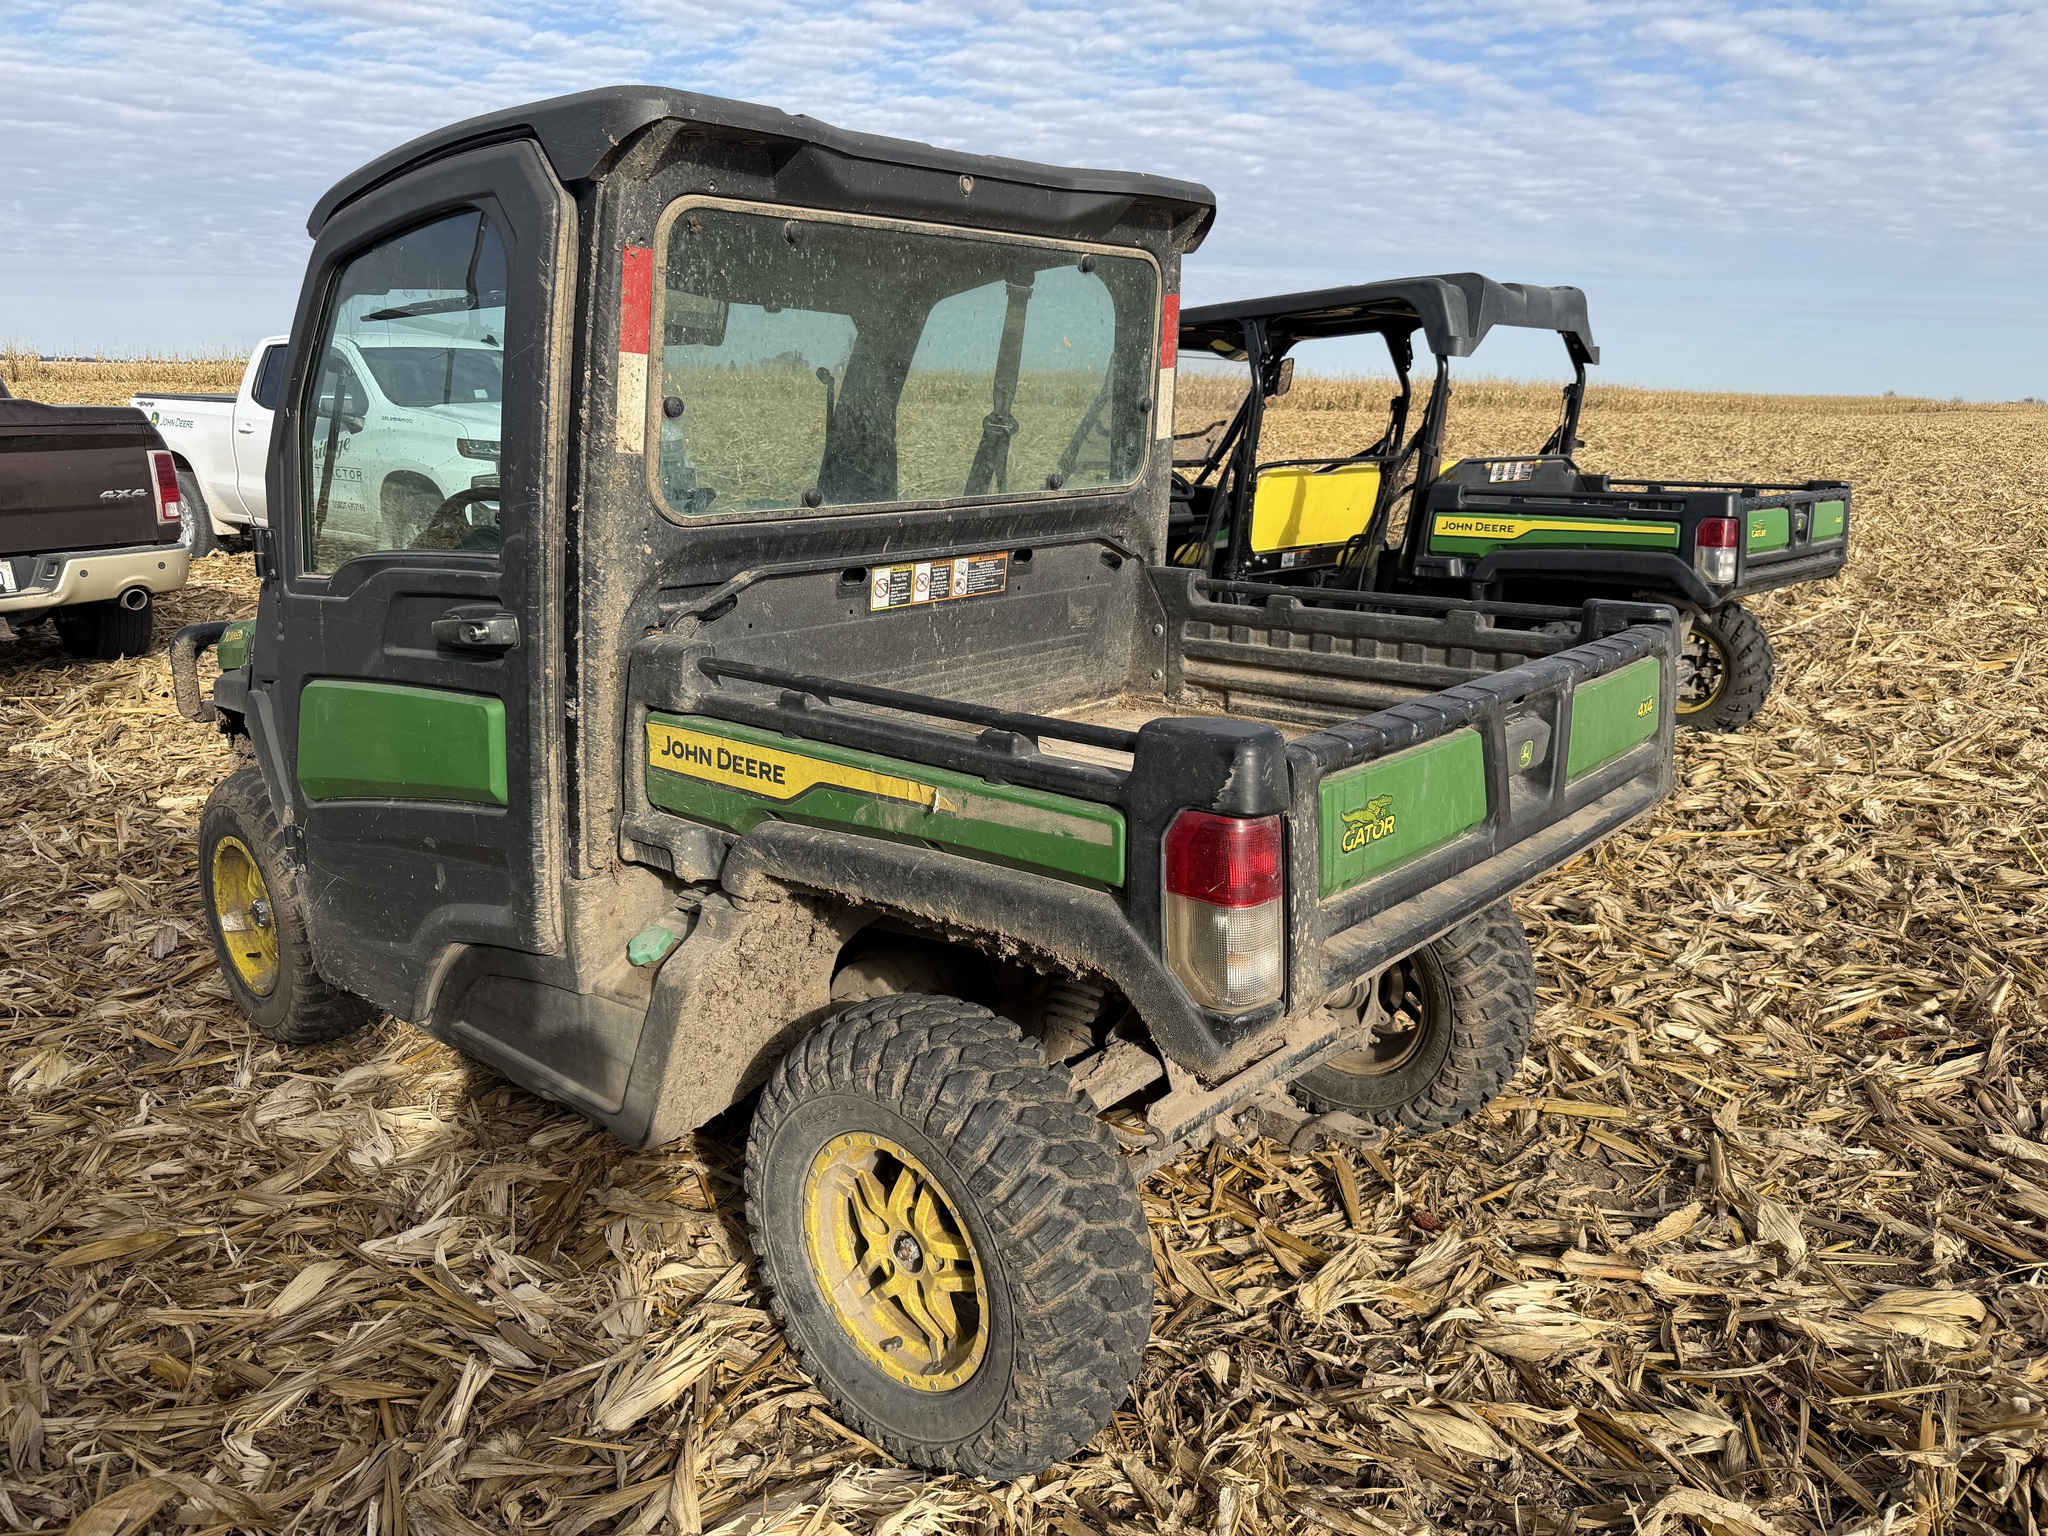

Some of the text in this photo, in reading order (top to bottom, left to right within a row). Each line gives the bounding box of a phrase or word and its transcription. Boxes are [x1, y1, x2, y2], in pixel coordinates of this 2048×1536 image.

[159, 416, 194, 429] JOHN DEERE
[315, 466, 362, 480] TCTOR
[1441, 520, 1515, 533] JOHN DEERE
[661, 735, 786, 785] JOHN DEERE
[1342, 814, 1396, 854] GATOR
